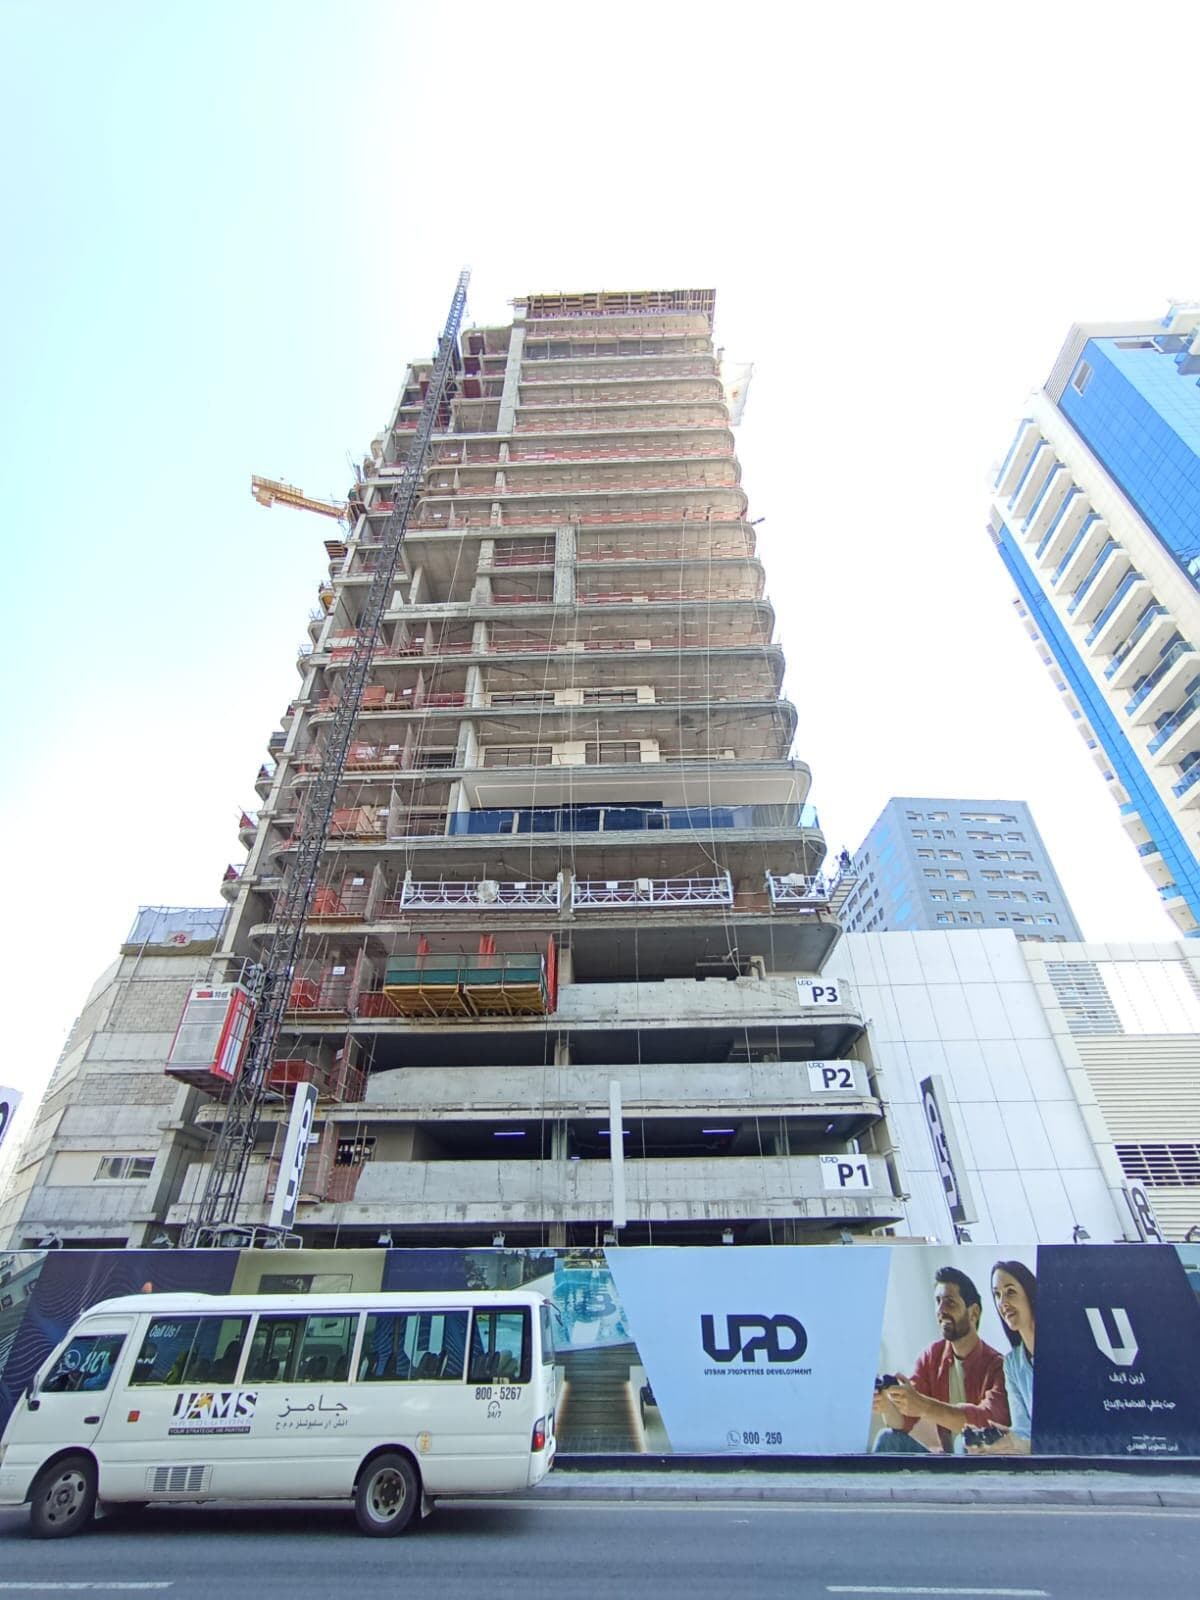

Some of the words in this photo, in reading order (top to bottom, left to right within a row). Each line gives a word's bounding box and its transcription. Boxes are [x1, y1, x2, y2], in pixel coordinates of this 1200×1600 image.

[812, 986, 838, 1003] P3
[822, 1068, 853, 1088] P2
[837, 1163, 869, 1187] P1
[701, 1314, 808, 1362] UPD
[766, 1368, 812, 1376] DEVELOPMENT
[475, 1386, 493, 1401] 800
[499, 1386, 522, 1401] 5267
[173, 1392, 258, 1420] JAMS
[278, 1394, 348, 1418] جامز
